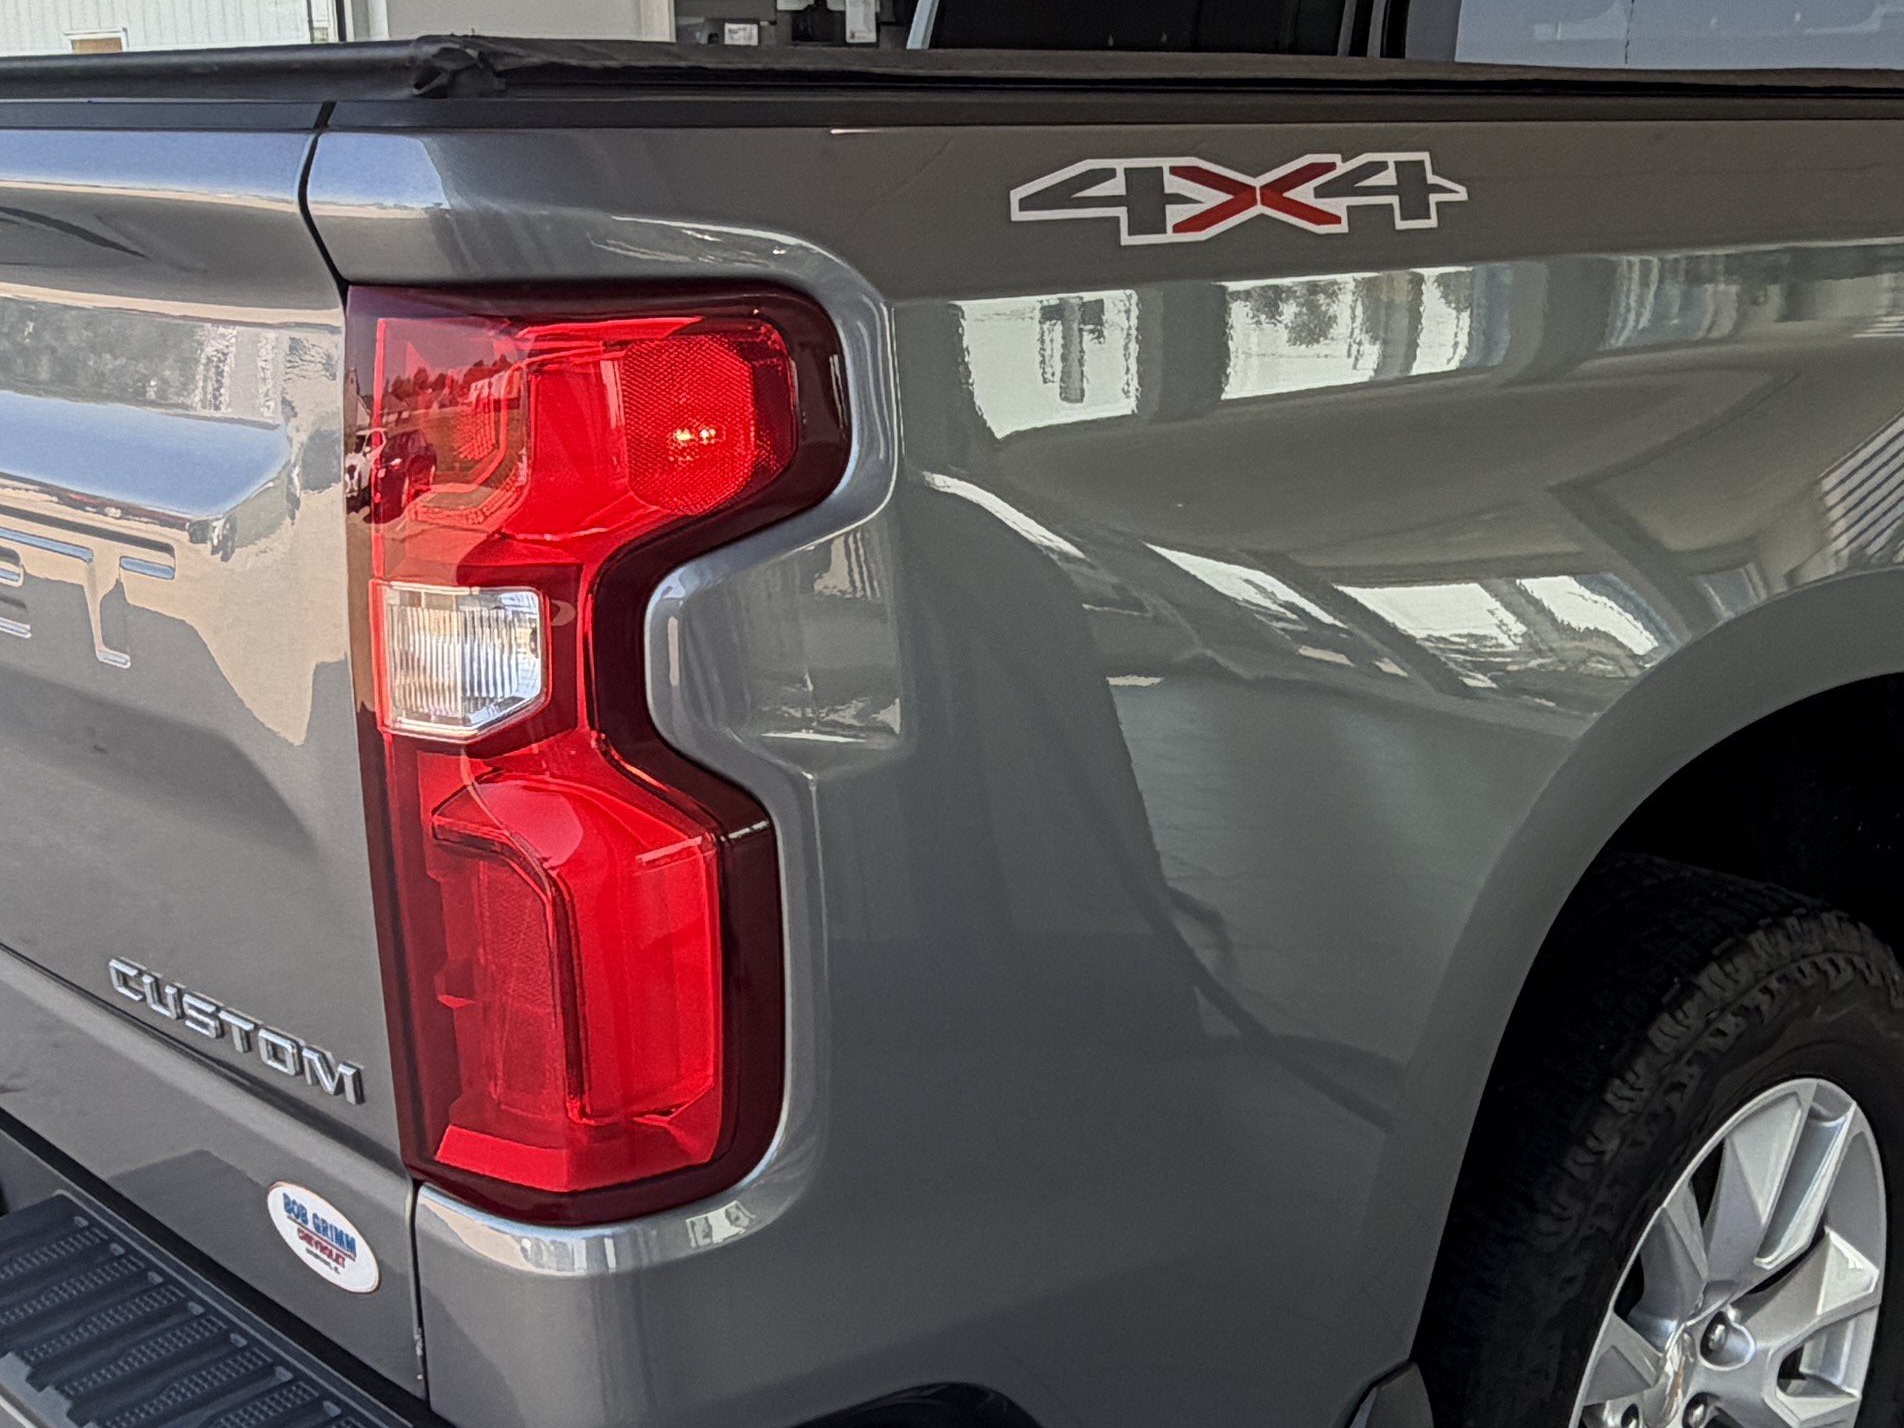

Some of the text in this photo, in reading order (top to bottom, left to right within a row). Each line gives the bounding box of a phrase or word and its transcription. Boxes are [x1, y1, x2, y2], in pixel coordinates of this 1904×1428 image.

[108, 956, 365, 1105] CUSTOM
[283, 1192, 357, 1258] BOB GRIMM
